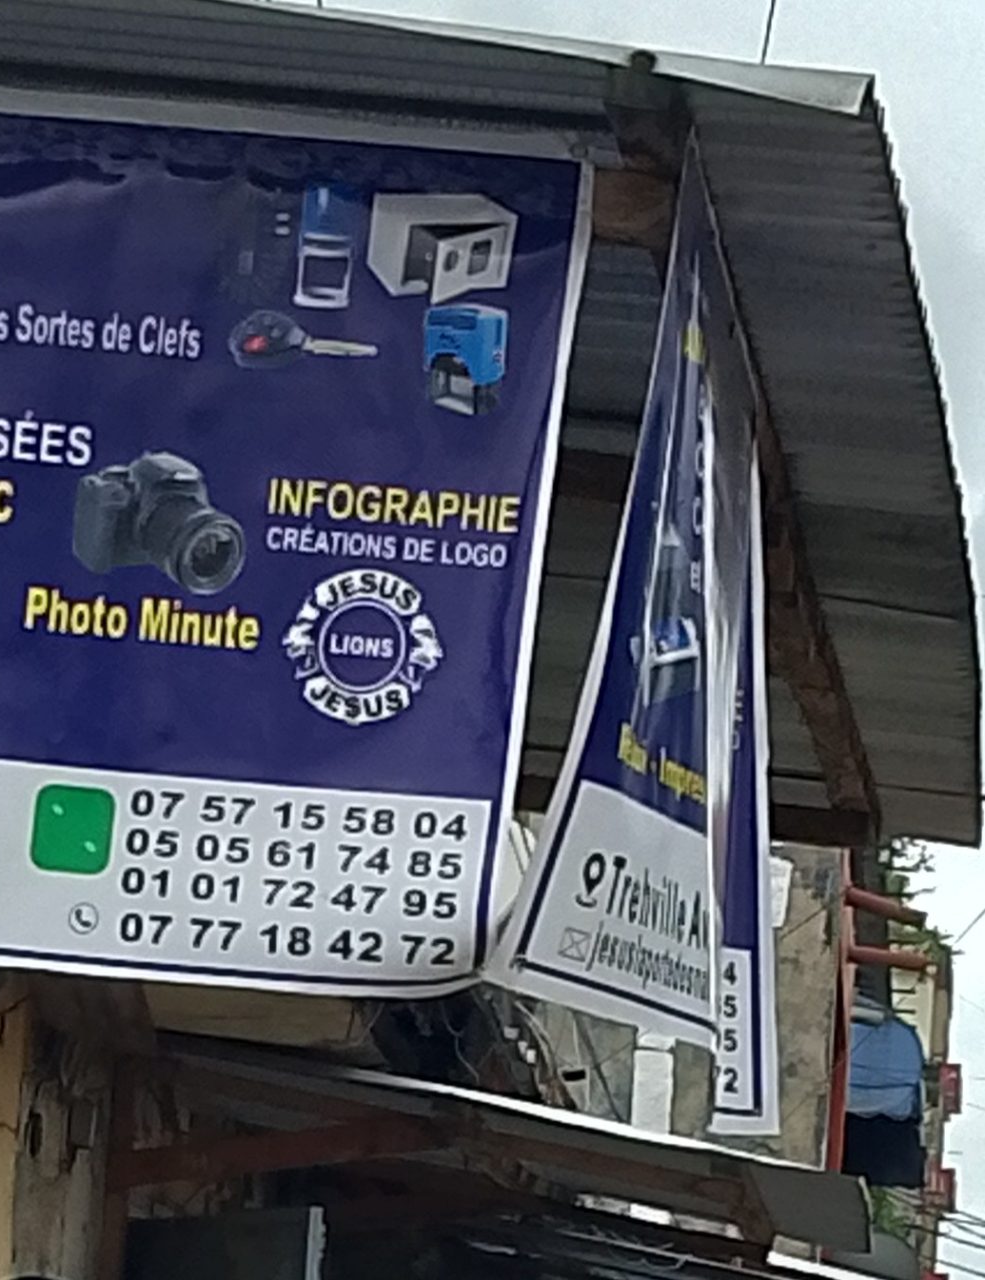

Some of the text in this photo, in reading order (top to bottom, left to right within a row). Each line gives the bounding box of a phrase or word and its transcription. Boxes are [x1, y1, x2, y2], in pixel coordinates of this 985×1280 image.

[16, 305, 94, 350] Sortes
[102, 313, 131, 353] de
[139, 315, 201, 359] Clefs
[267, 478, 521, 533] INFOGRAPHIE
[267, 525, 508, 568] CRÉATIONS DE LOGO
[324, 572, 419, 612] JESUS
[24, 587, 260, 651] Photo Minute
[330, 634, 394, 658] LIONS
[309, 688, 405, 719] JESUS
[130, 790, 468, 841] 07 57 15 58 04
[126, 828, 462, 880] 05 05 61 74 85
[121, 867, 457, 920] 01 01 72 47 95
[120, 913, 456, 966] 07 77 18 42 72
